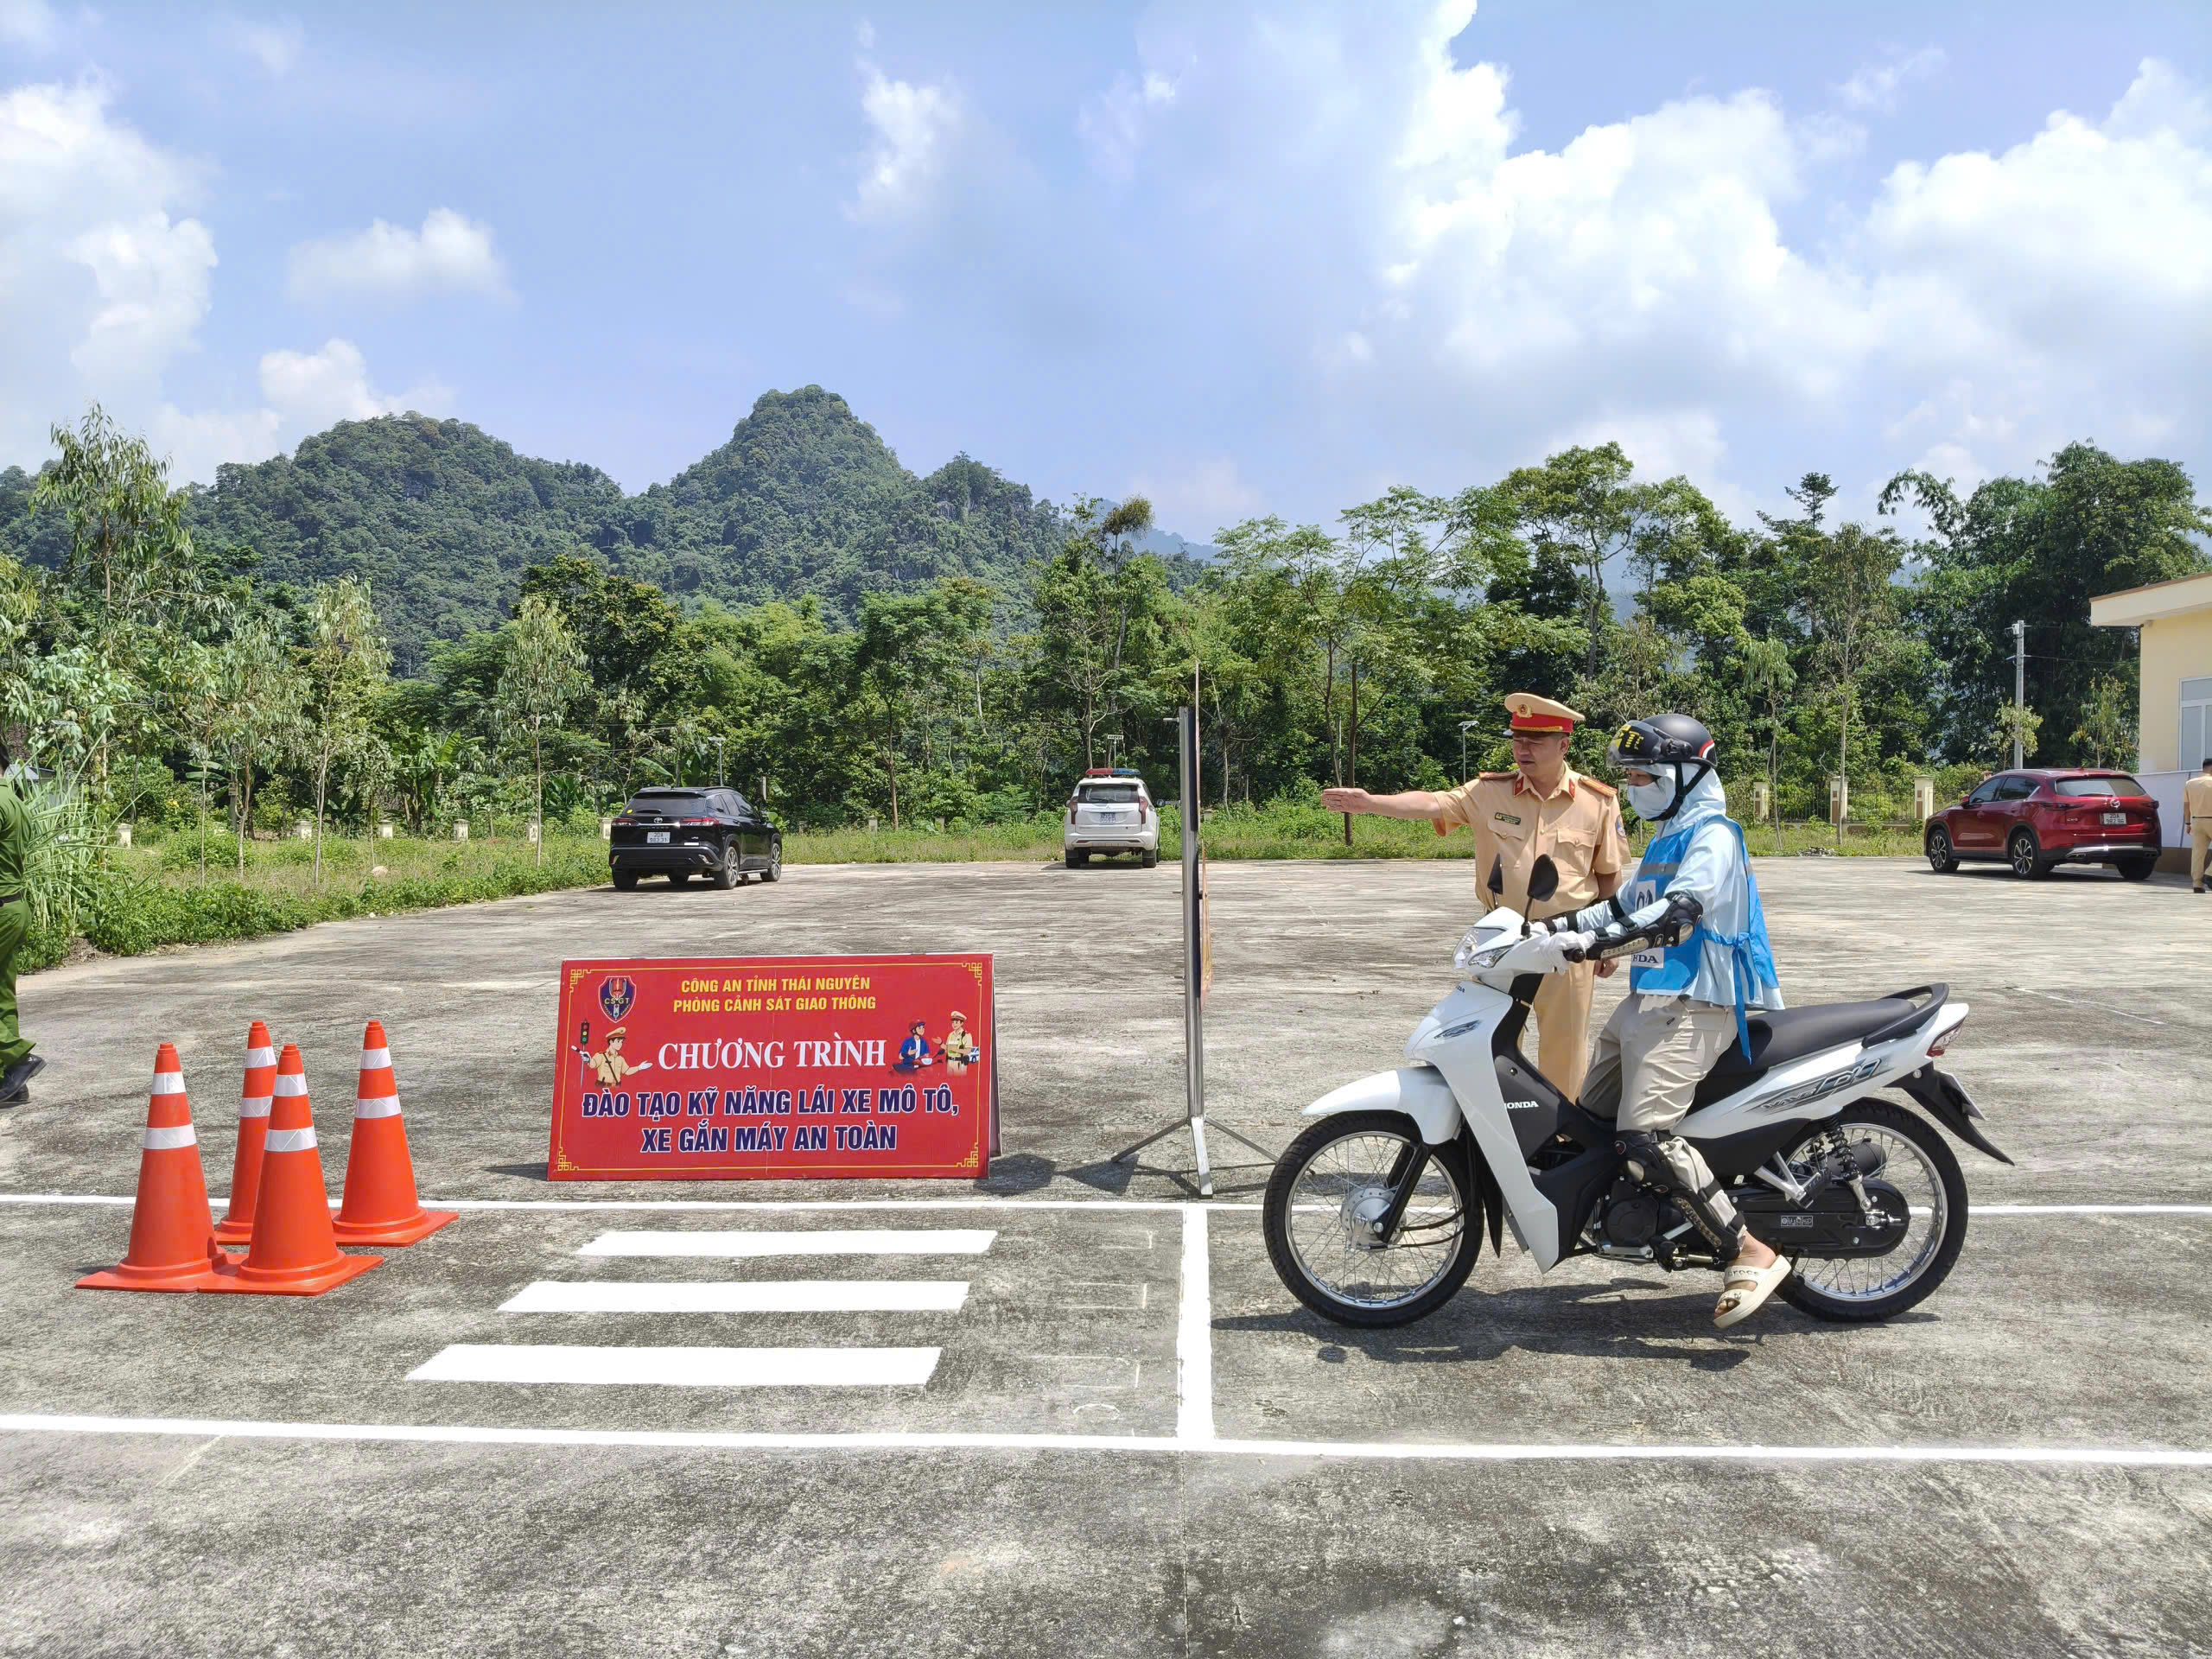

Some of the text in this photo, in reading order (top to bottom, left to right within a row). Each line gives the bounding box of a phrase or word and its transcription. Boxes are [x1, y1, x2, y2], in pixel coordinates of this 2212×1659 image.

[682, 975, 869, 992] CÔNG AN TỈNH THÁI NGUYÊN
[674, 995, 875, 1012] PHÒNG CẢNH SÁT GIAO THÔNG
[658, 1033, 886, 1069] CHƯƠNG TRÌNH
[582, 1083, 958, 1122] ĐÀO TẠO KỸ NĂNG LÁI XE MÔ TÔ,
[640, 1120, 897, 1153] XE GẮN MÁY AN TOÀN
